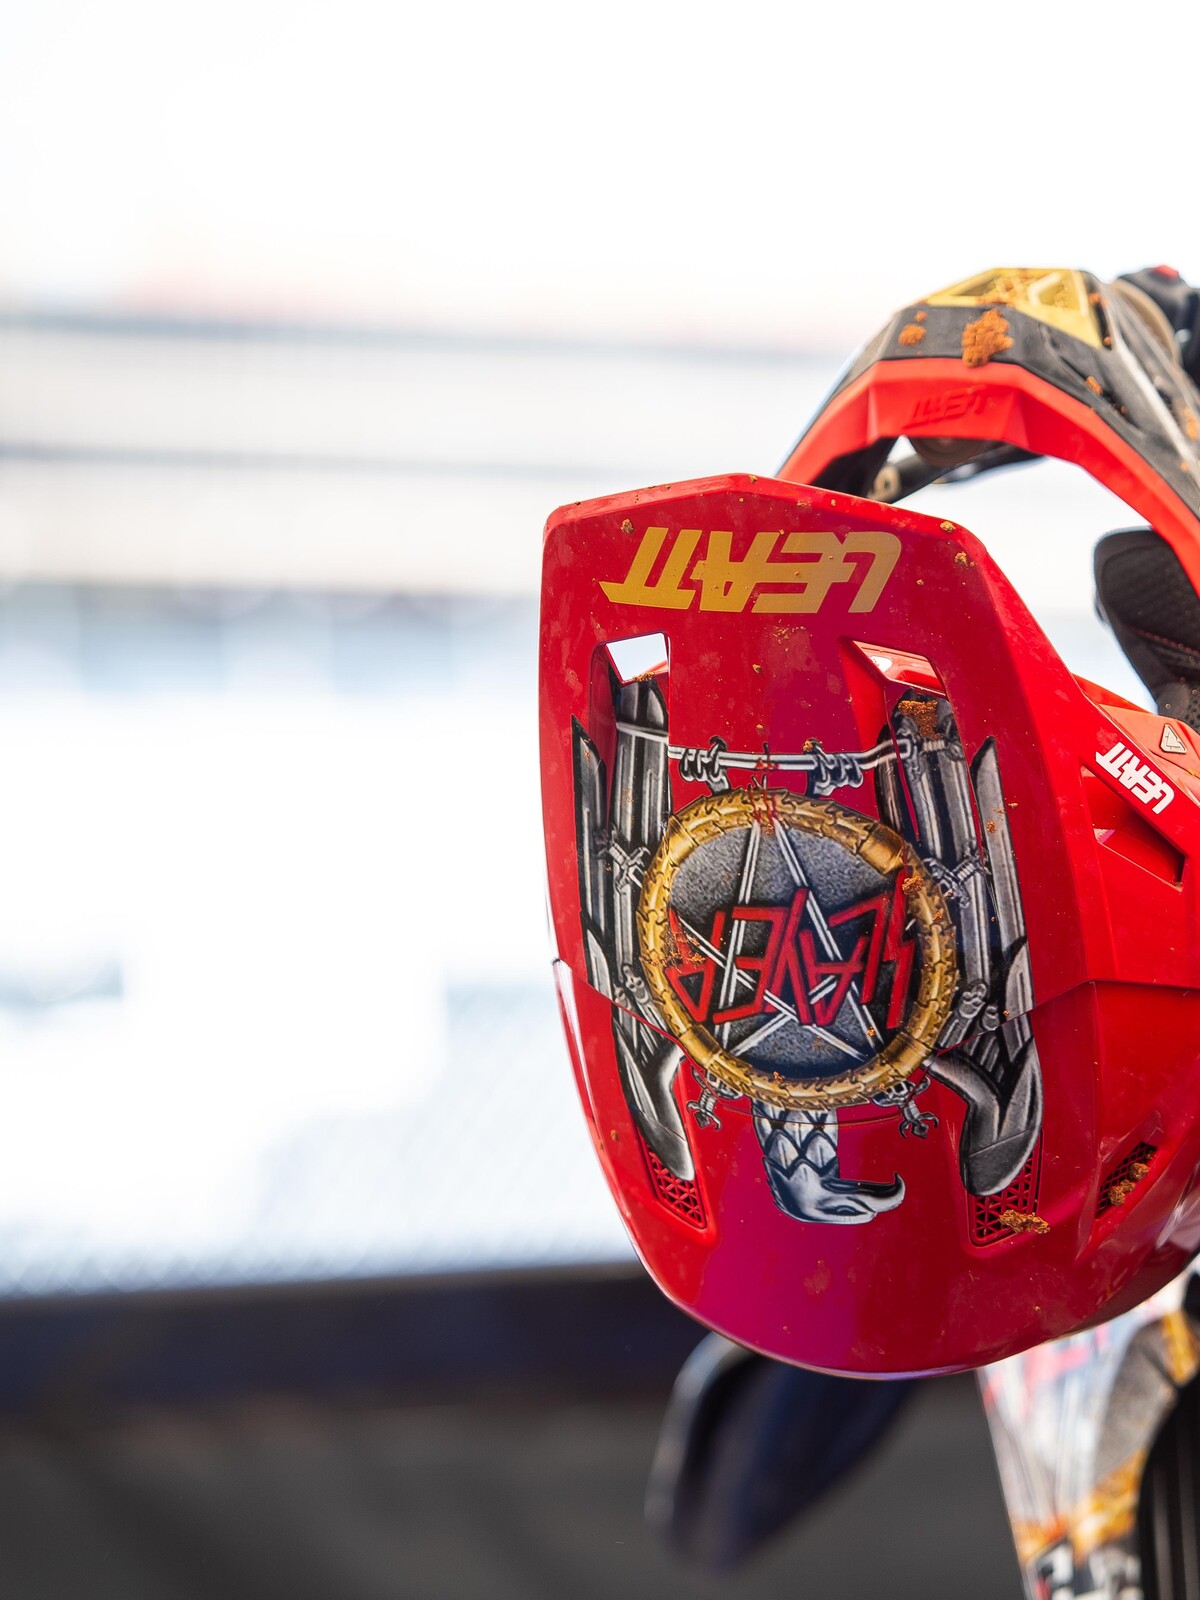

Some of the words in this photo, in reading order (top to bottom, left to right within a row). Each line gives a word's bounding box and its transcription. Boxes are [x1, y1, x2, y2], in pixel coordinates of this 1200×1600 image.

[599, 527, 901, 614] LEATT
[1095, 742, 1174, 814] LEATT
[664, 870, 915, 1029] SLAYER
